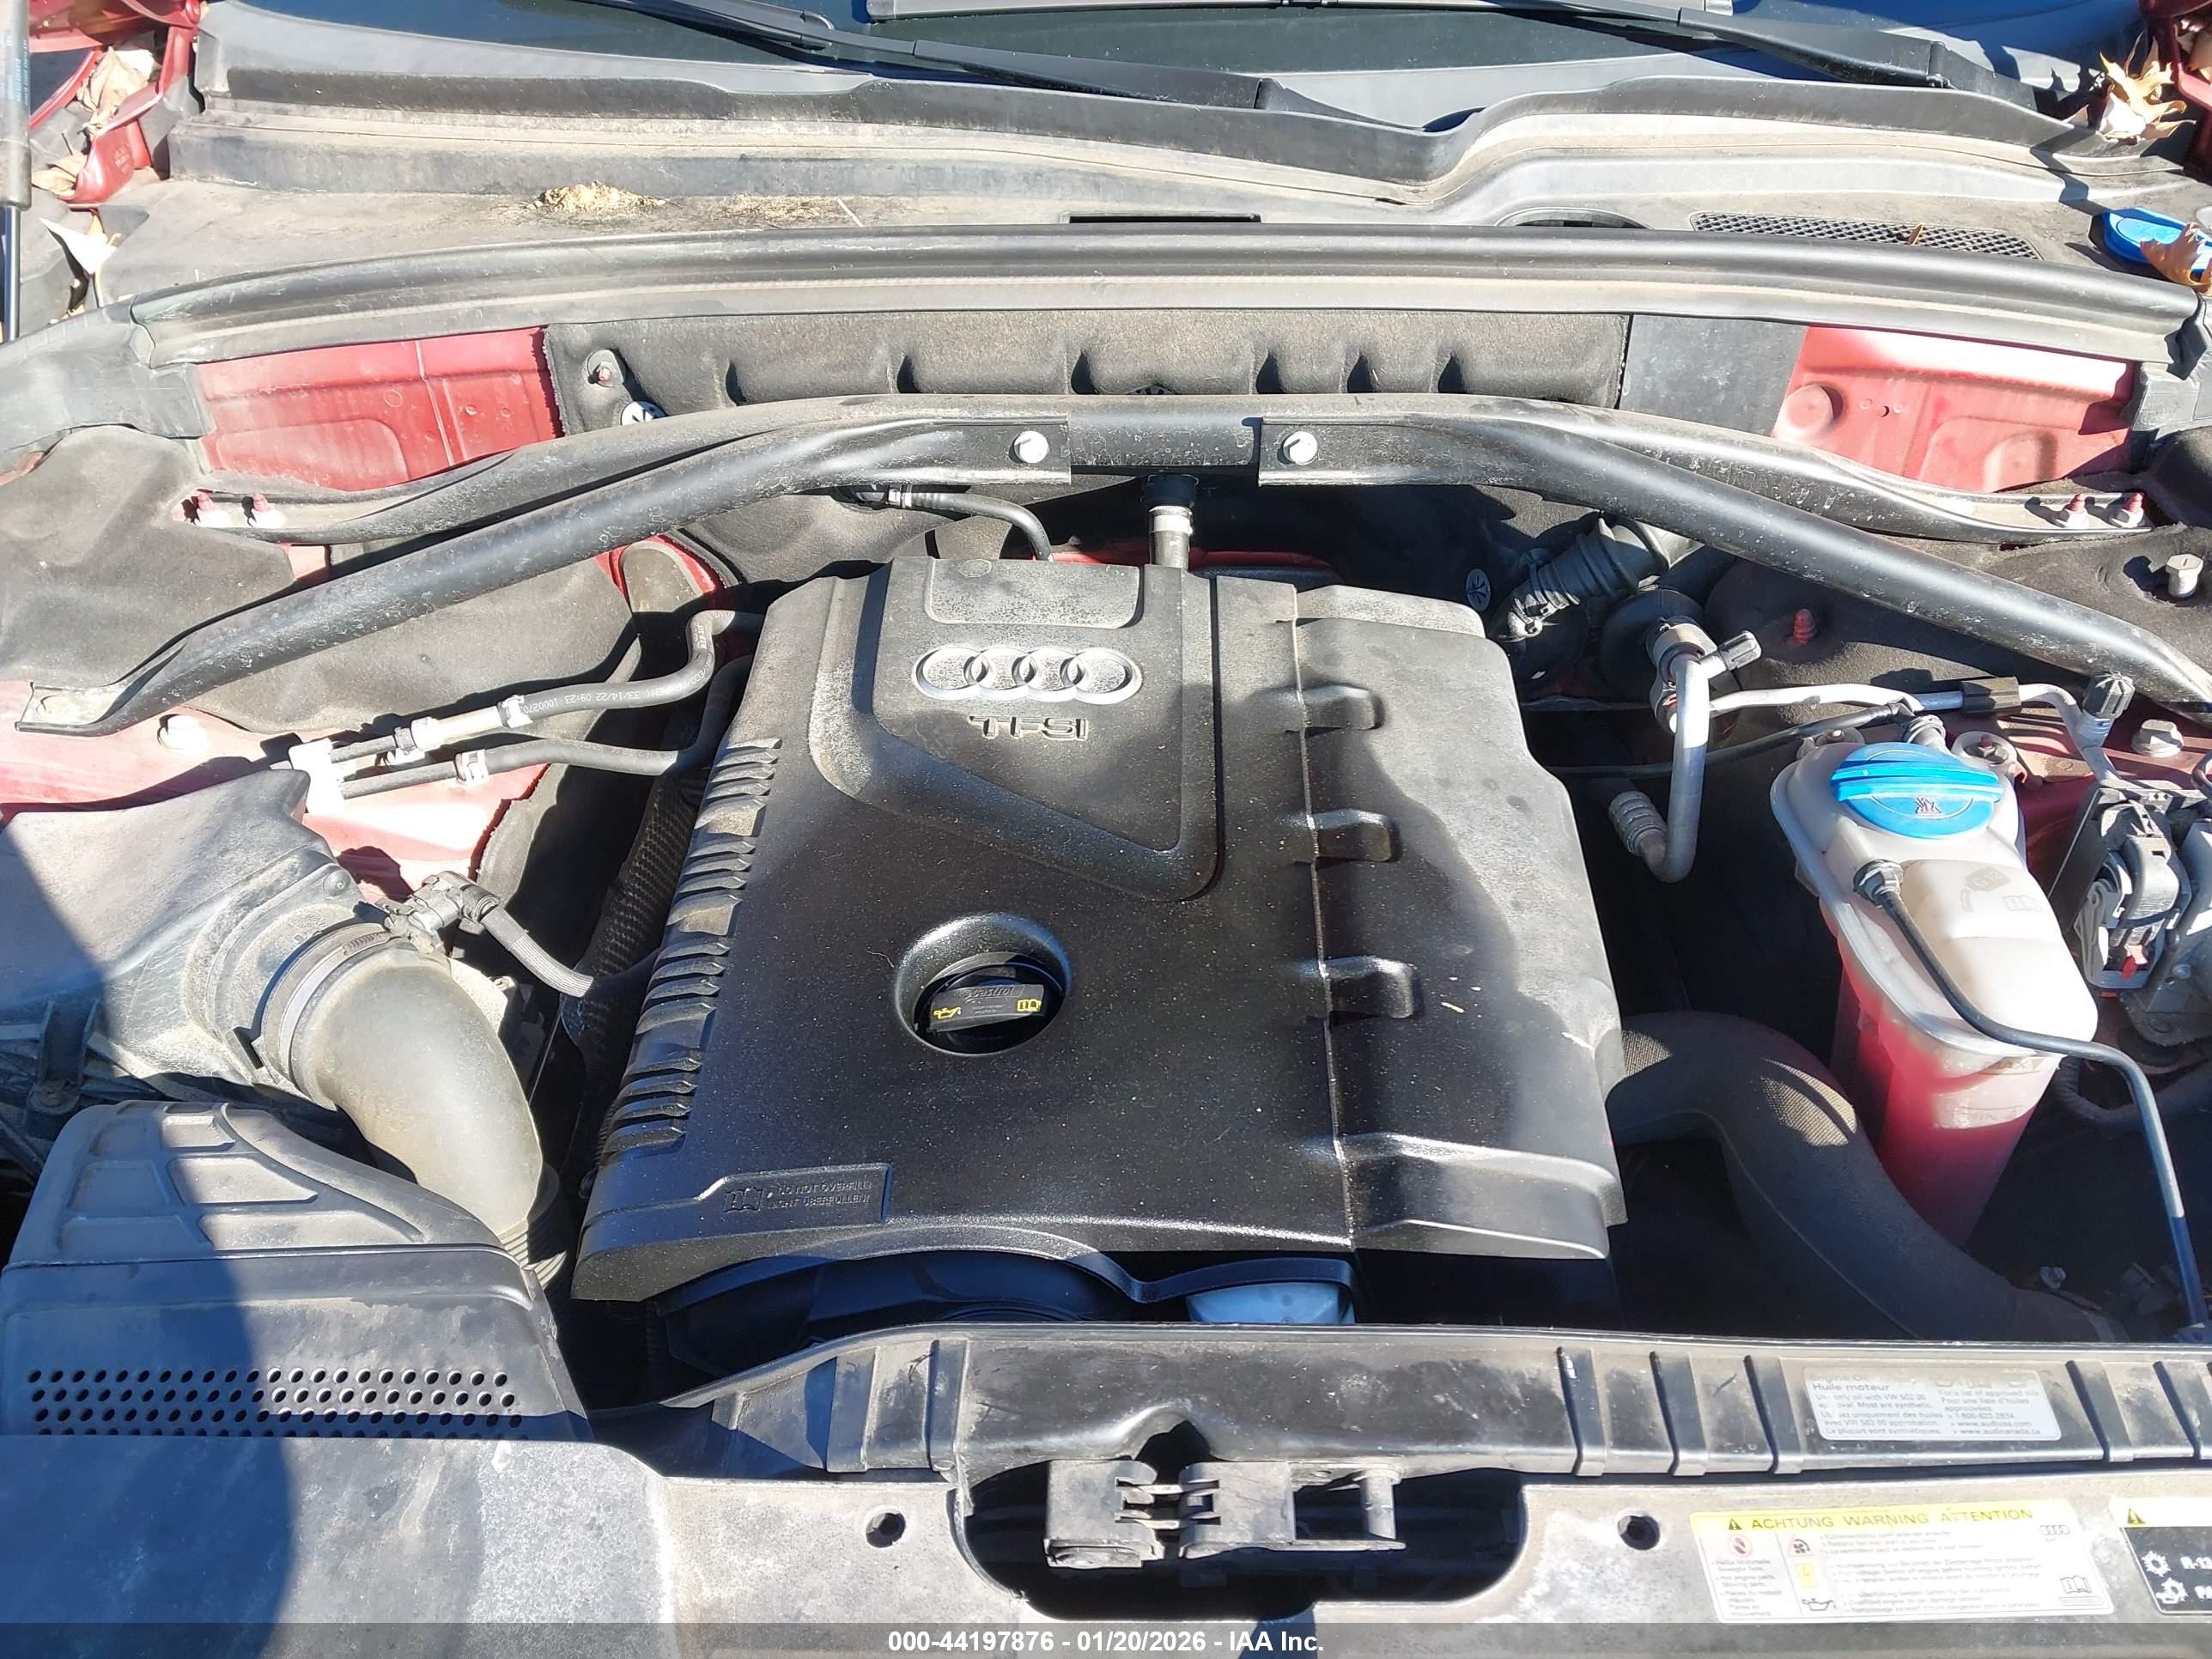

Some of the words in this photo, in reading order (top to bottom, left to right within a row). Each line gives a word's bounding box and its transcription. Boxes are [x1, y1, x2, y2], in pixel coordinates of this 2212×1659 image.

[969, 715, 1088, 741] TFSI
[796, 1184, 818, 1194] NOT
[1751, 1516, 1834, 1529] ACHTUNG
[1842, 1513, 1929, 1526] WARNING
[1940, 1510, 2033, 1522] ATTENTION
